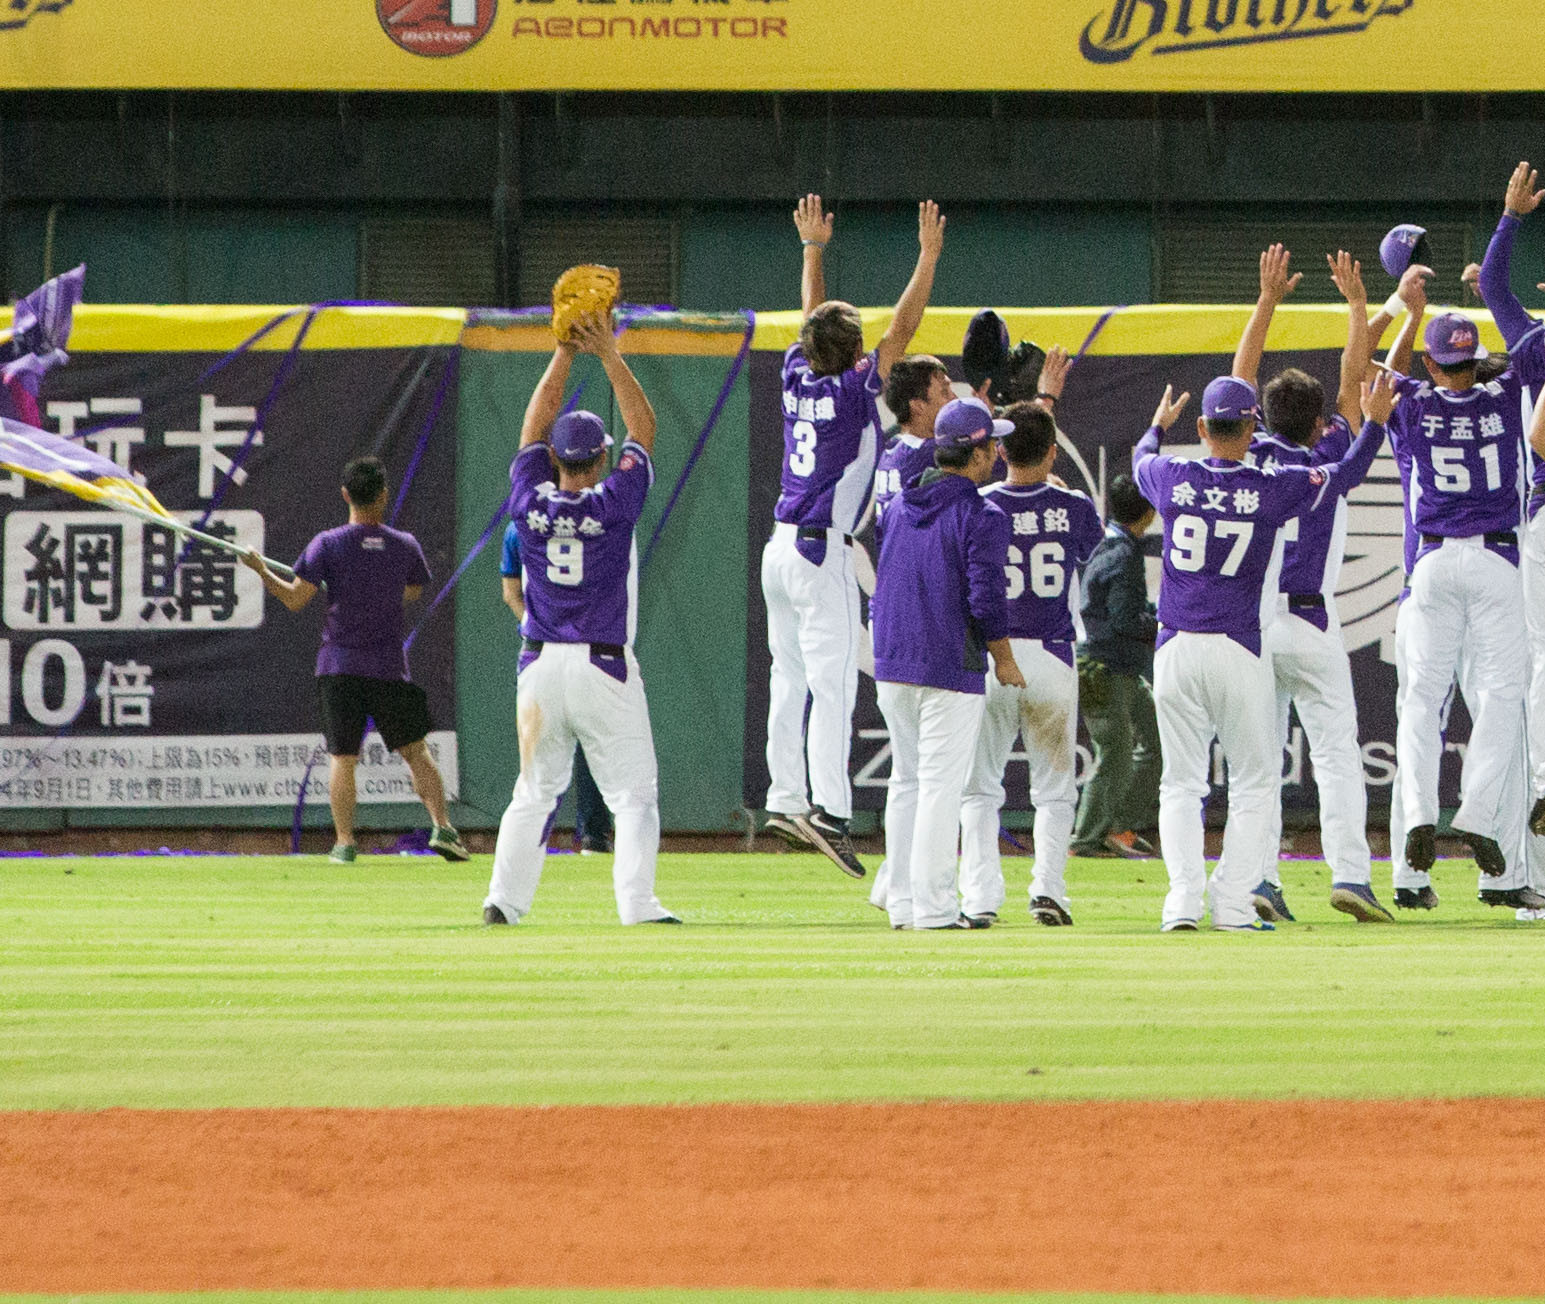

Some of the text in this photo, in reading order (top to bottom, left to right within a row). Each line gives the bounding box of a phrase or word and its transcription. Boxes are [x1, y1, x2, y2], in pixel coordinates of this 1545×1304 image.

[0, 395, 263, 498] 玩卡
[789, 420, 818, 477] 3
[1430, 442, 1501, 493] 51
[1011, 507, 1070, 536] 建銘
[1170, 514, 1255, 577] 97
[546, 537, 584, 587] 9
